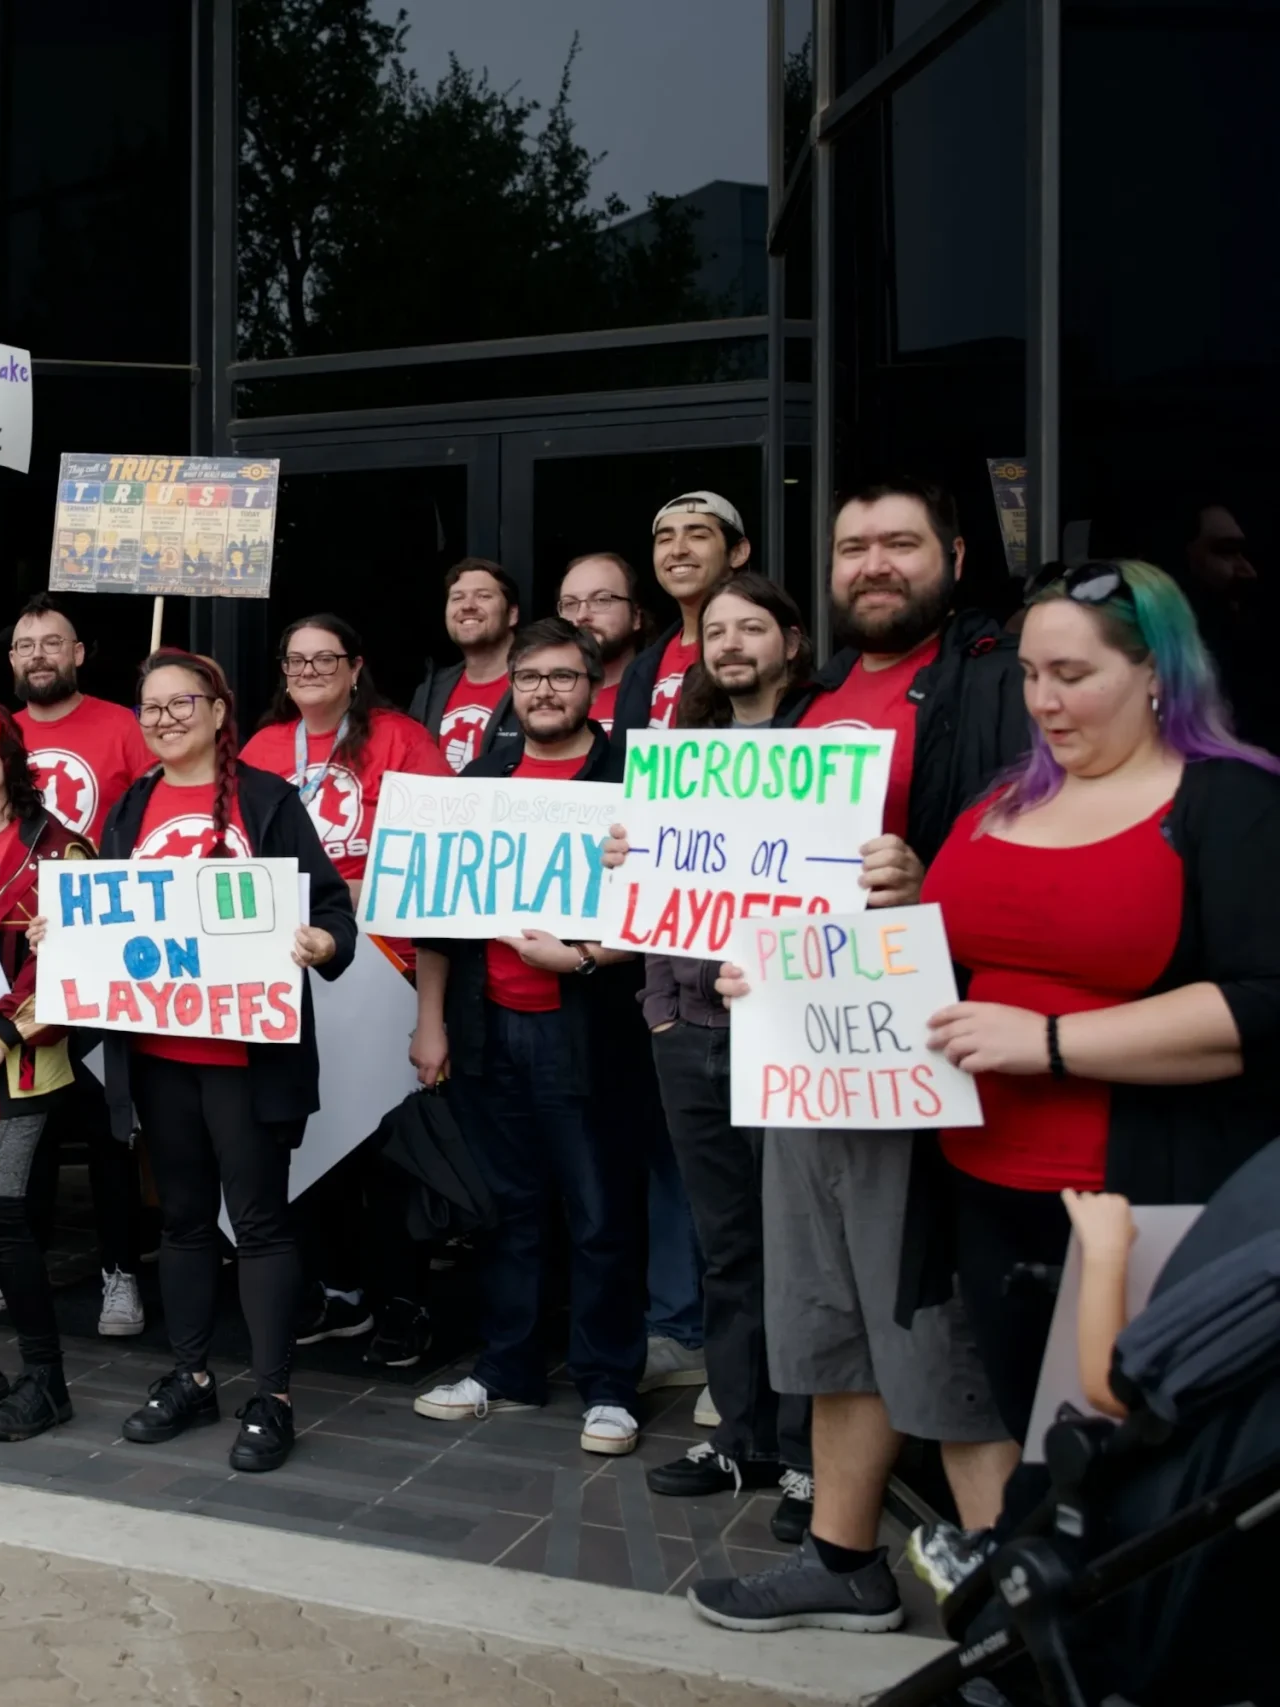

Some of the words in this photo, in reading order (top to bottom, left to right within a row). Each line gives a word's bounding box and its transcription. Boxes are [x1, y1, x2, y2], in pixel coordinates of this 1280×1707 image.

[74, 482, 89, 502] T
[112, 483, 132, 504] R
[156, 485, 175, 505] U
[199, 486, 215, 506] S
[244, 487, 260, 508] T
[108, 457, 186, 483] TRUST
[624, 740, 881, 805] MICROSOFT
[381, 777, 483, 828] Devs
[489, 789, 617, 828] Deserve
[364, 828, 610, 922] FAIRPLAY
[655, 826, 727, 873] runs
[751, 838, 788, 883] on
[59, 870, 174, 927] HIT
[620, 883, 830, 951] LAYO
[123, 935, 201, 980] ON
[756, 923, 919, 981] PEOPLE
[60, 978, 298, 1041] LAYOFFS
[805, 1001, 912, 1054] OVER
[761, 1064, 943, 1122] PROFITS
